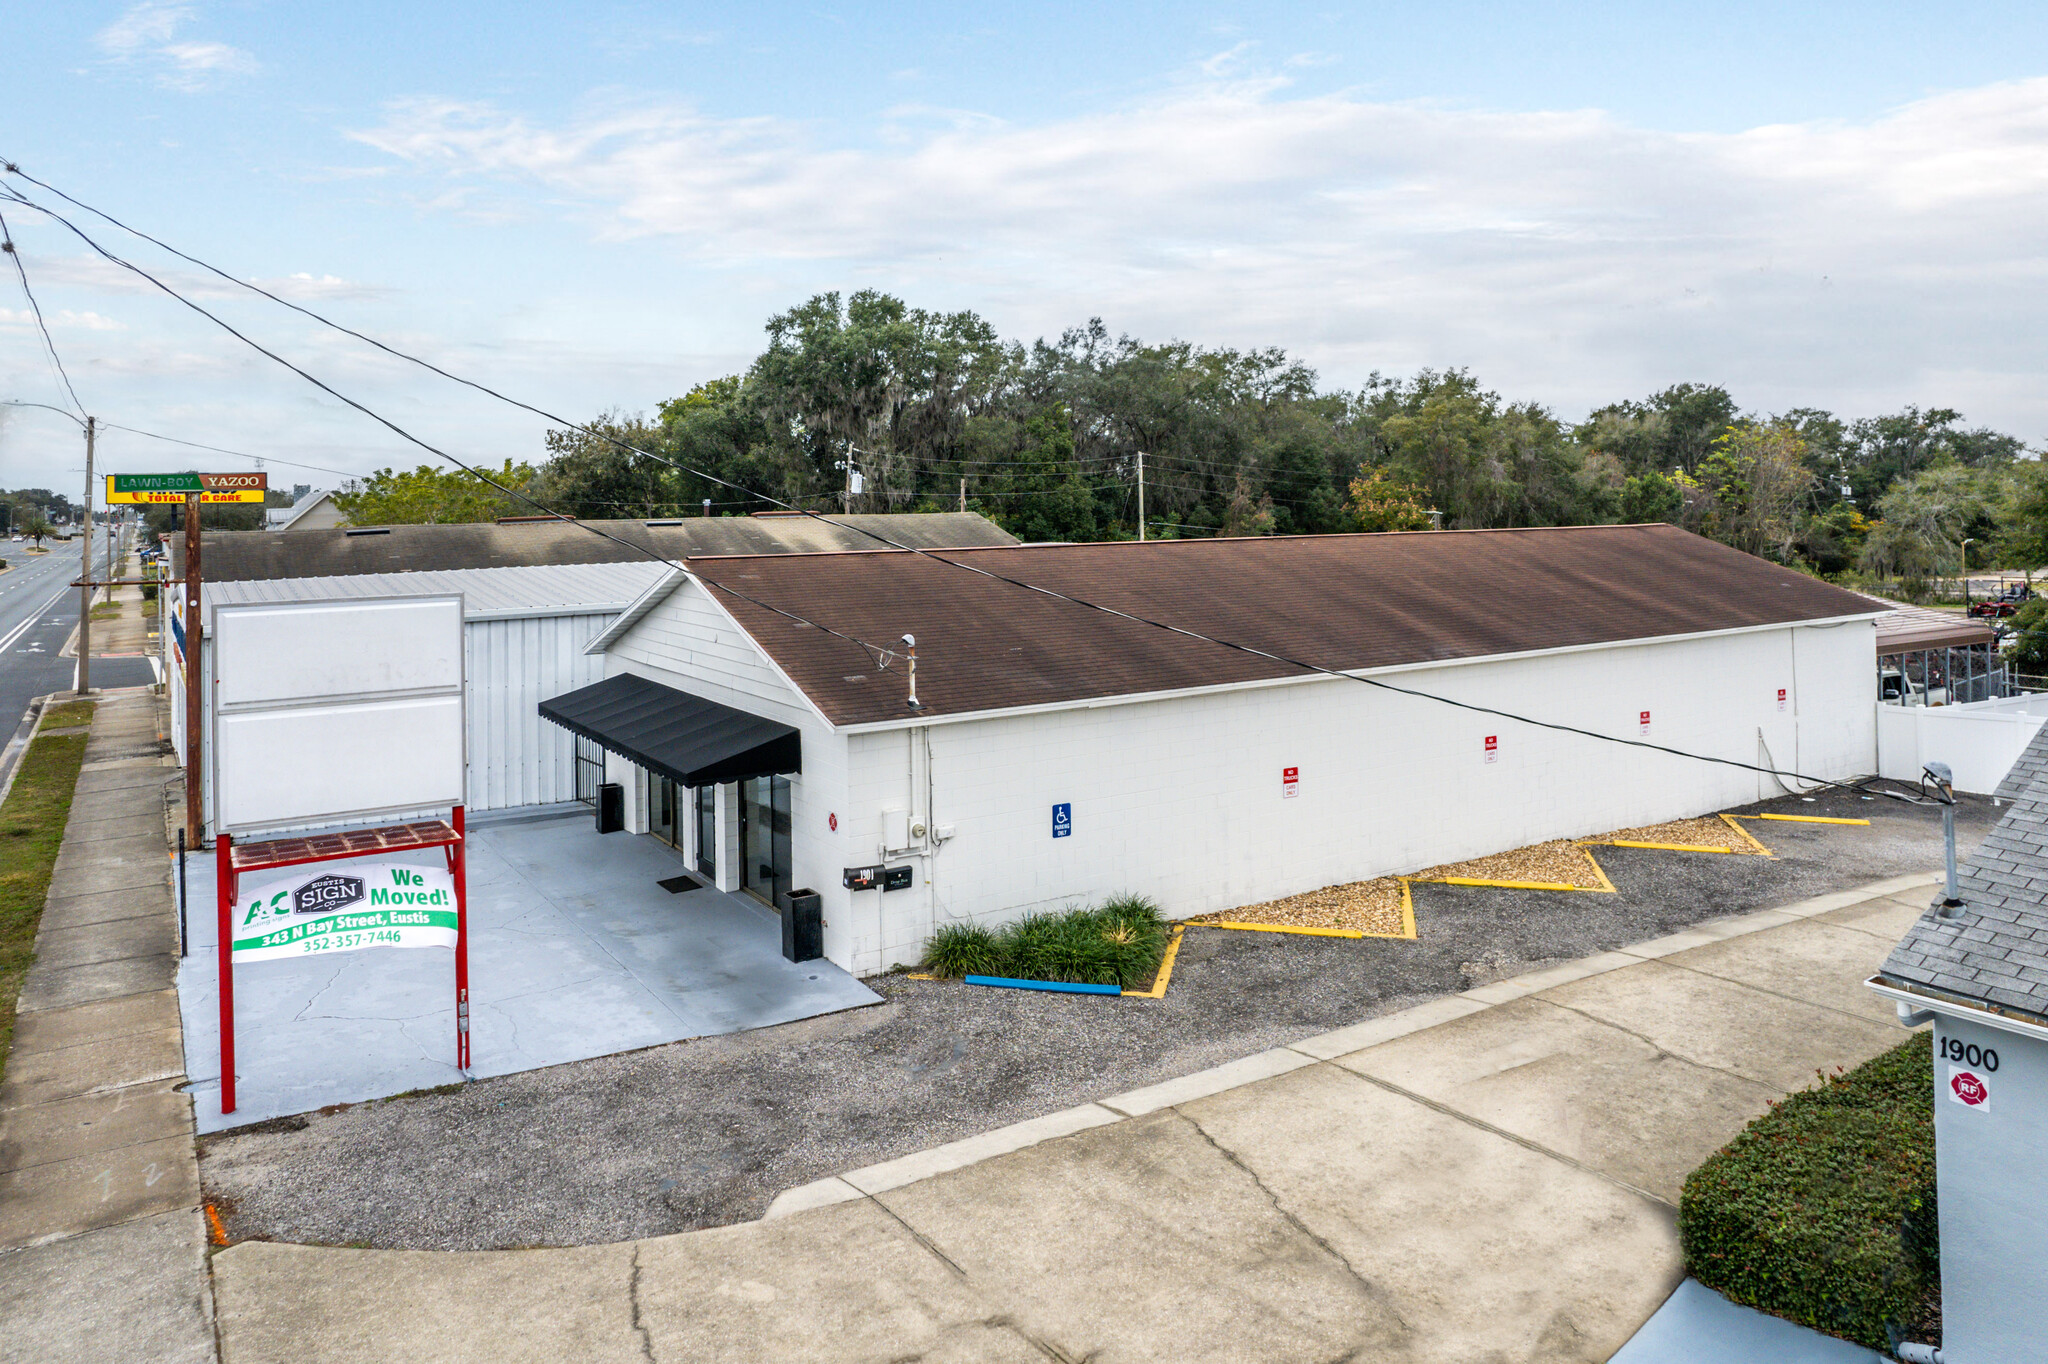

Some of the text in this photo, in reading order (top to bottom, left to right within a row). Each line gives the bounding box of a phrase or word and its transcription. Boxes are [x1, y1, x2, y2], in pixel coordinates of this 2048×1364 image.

[121, 477, 194, 488] LAWN-BOY
[208, 476, 260, 487] YAZOO
[212, 494, 242, 502] CARE
[311, 878, 345, 889] EUSTIS
[391, 868, 424, 886] We
[301, 883, 357, 909] SIGN
[371, 888, 449, 906] Moved!
[243, 891, 290, 925] A&C
[242, 914, 290, 932] printing signs
[261, 911, 430, 947] 343 N Bay Street, Eustis
[303, 930, 401, 952] 352-357-7446
[1940, 1036, 2000, 1072] 1900
[1960, 1082, 1977, 1094] RF
